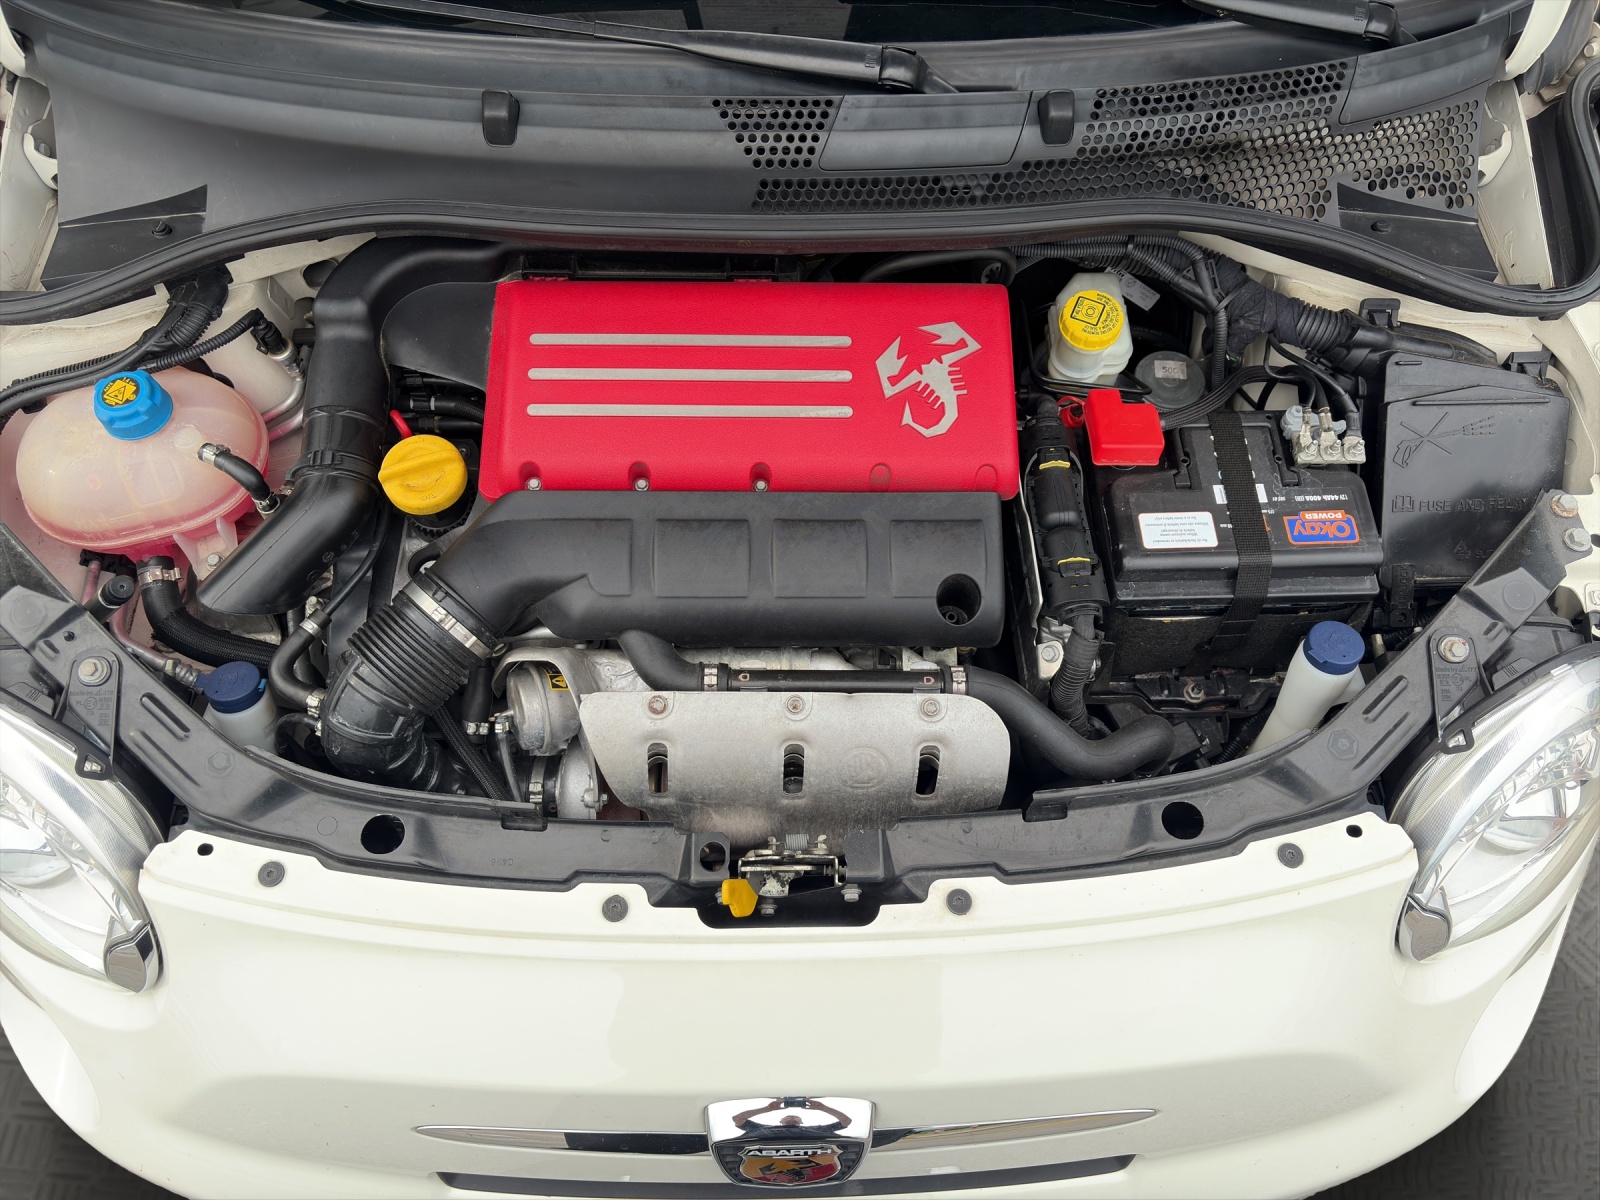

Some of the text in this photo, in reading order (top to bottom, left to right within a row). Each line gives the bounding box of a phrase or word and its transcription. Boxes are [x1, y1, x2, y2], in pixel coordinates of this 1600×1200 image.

[1418, 497, 1527, 512] FUSE AND RELAY
[1305, 512, 1343, 520] POWER
[1294, 520, 1351, 538] Okay
